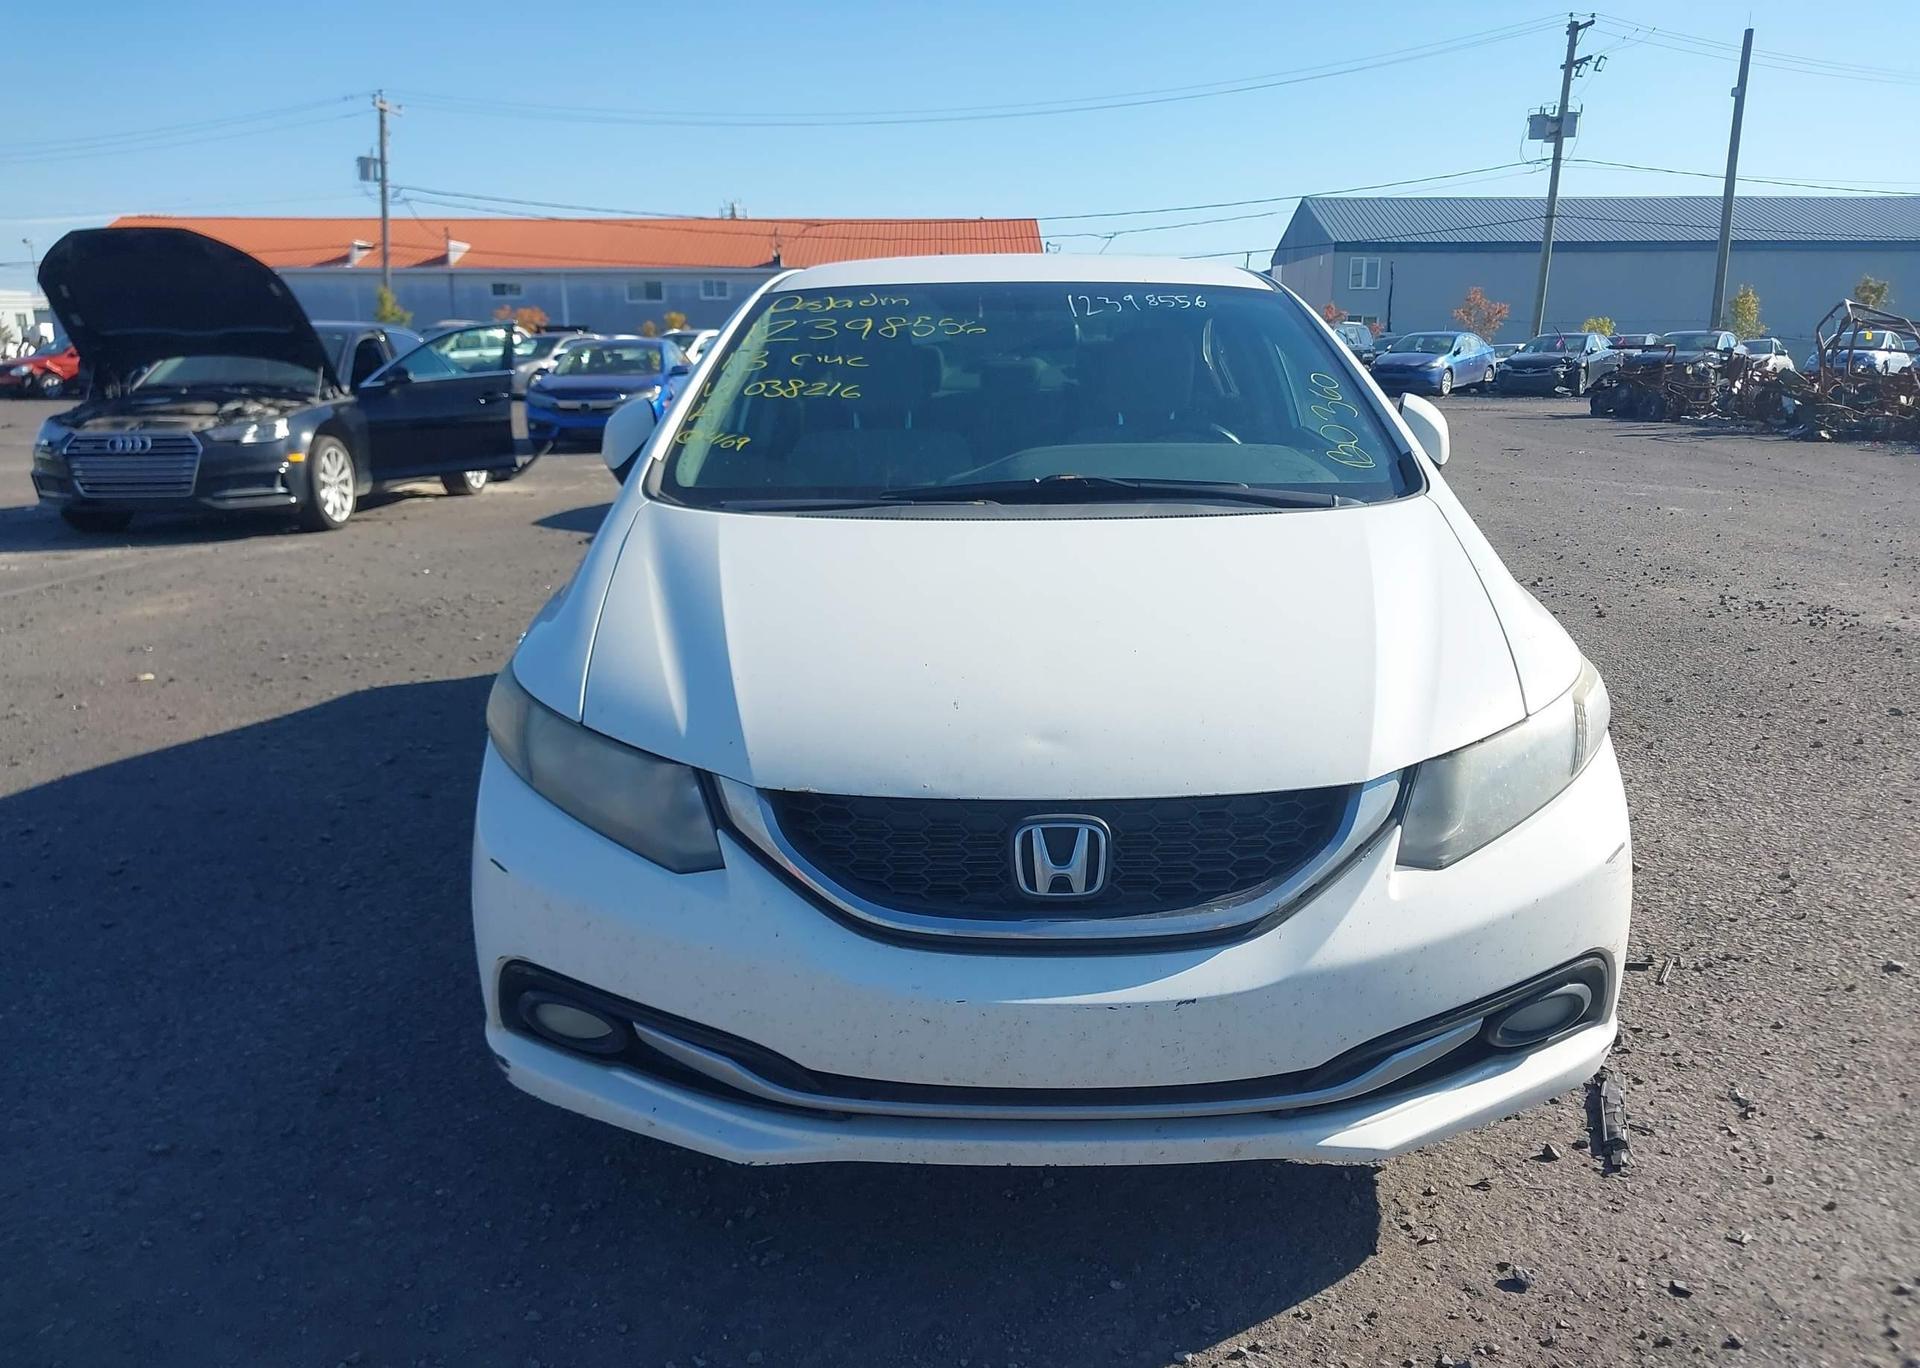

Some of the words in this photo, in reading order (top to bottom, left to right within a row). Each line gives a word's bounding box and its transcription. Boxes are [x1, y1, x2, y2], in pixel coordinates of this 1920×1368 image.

[1066, 293, 1207, 318] 12398556
[757, 316, 987, 342] 2398556
[1030, 825, 1090, 894] H
